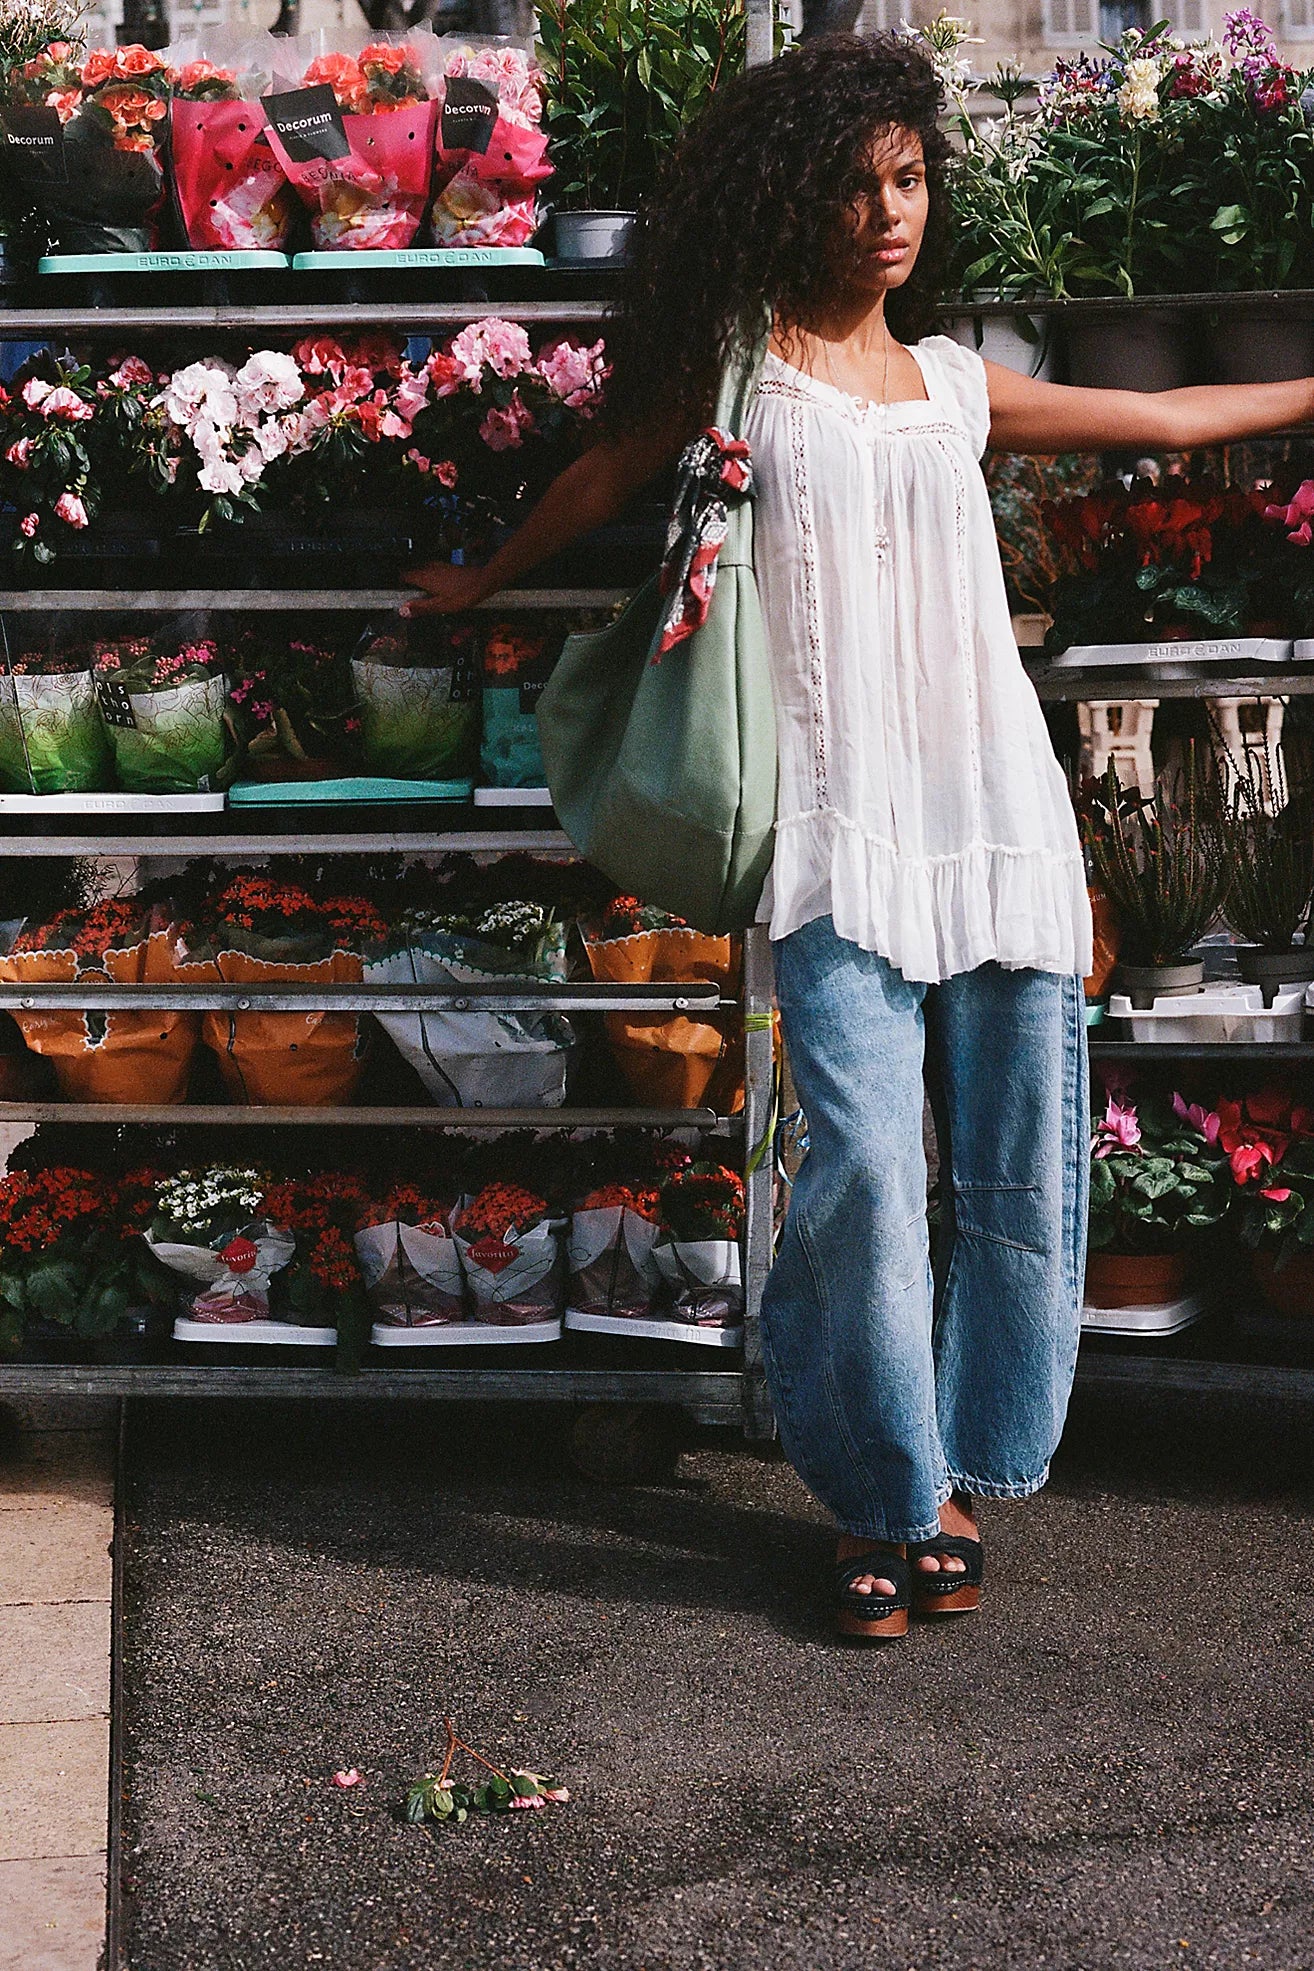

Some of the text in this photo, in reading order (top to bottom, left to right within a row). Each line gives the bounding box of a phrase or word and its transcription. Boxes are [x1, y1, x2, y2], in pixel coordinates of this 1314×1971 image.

[276, 112, 332, 133] Decorum
[7, 133, 54, 145] Decorum
[138, 256, 181, 267] EURO
[198, 255, 232, 265] DAN
[396, 252, 441, 263] EURO
[458, 252, 493, 262] DAN
[1147, 647, 1191, 658] EURO
[1207, 643, 1242, 654] DAN
[101, 695, 130, 710] tho
[105, 712, 135, 726] orn
